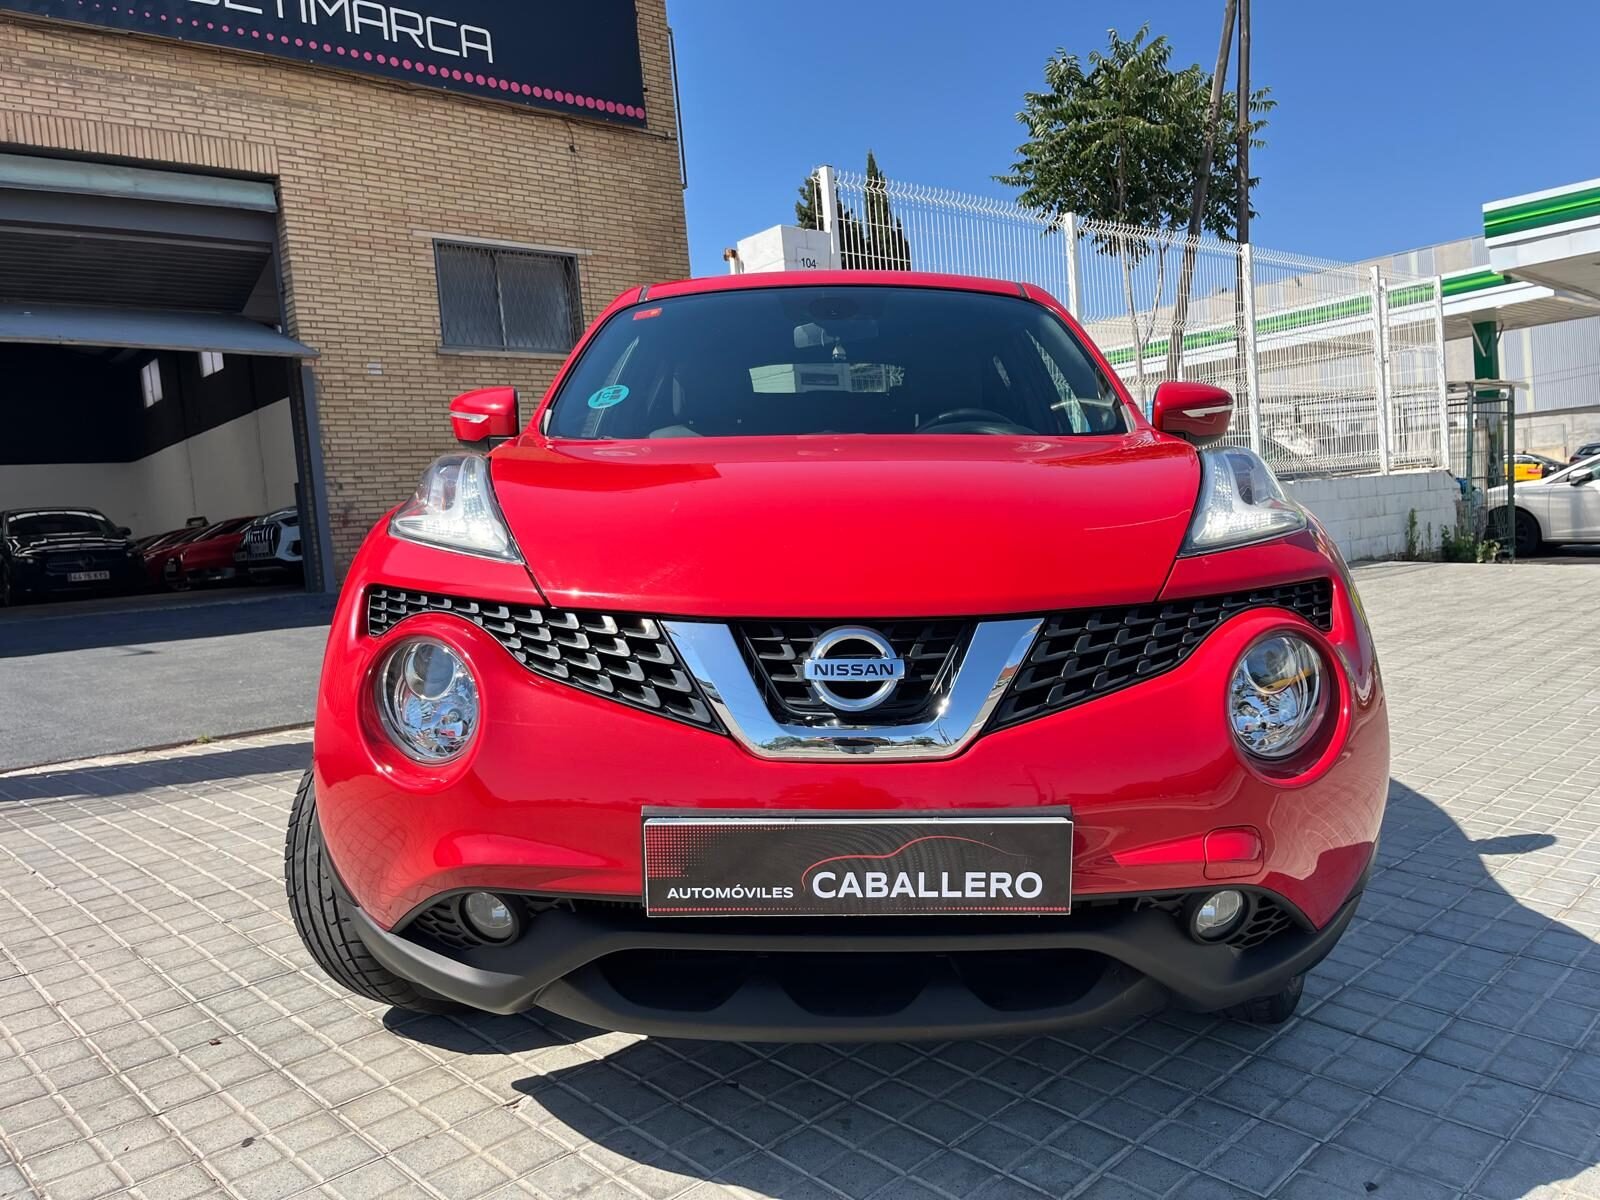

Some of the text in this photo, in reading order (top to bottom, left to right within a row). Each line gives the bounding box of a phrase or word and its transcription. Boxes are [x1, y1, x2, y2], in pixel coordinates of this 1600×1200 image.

[801, 257, 816, 269] 104
[814, 663, 894, 676] NISSAN
[667, 871, 1043, 899] AUTOMÓVILES CABALLERO
